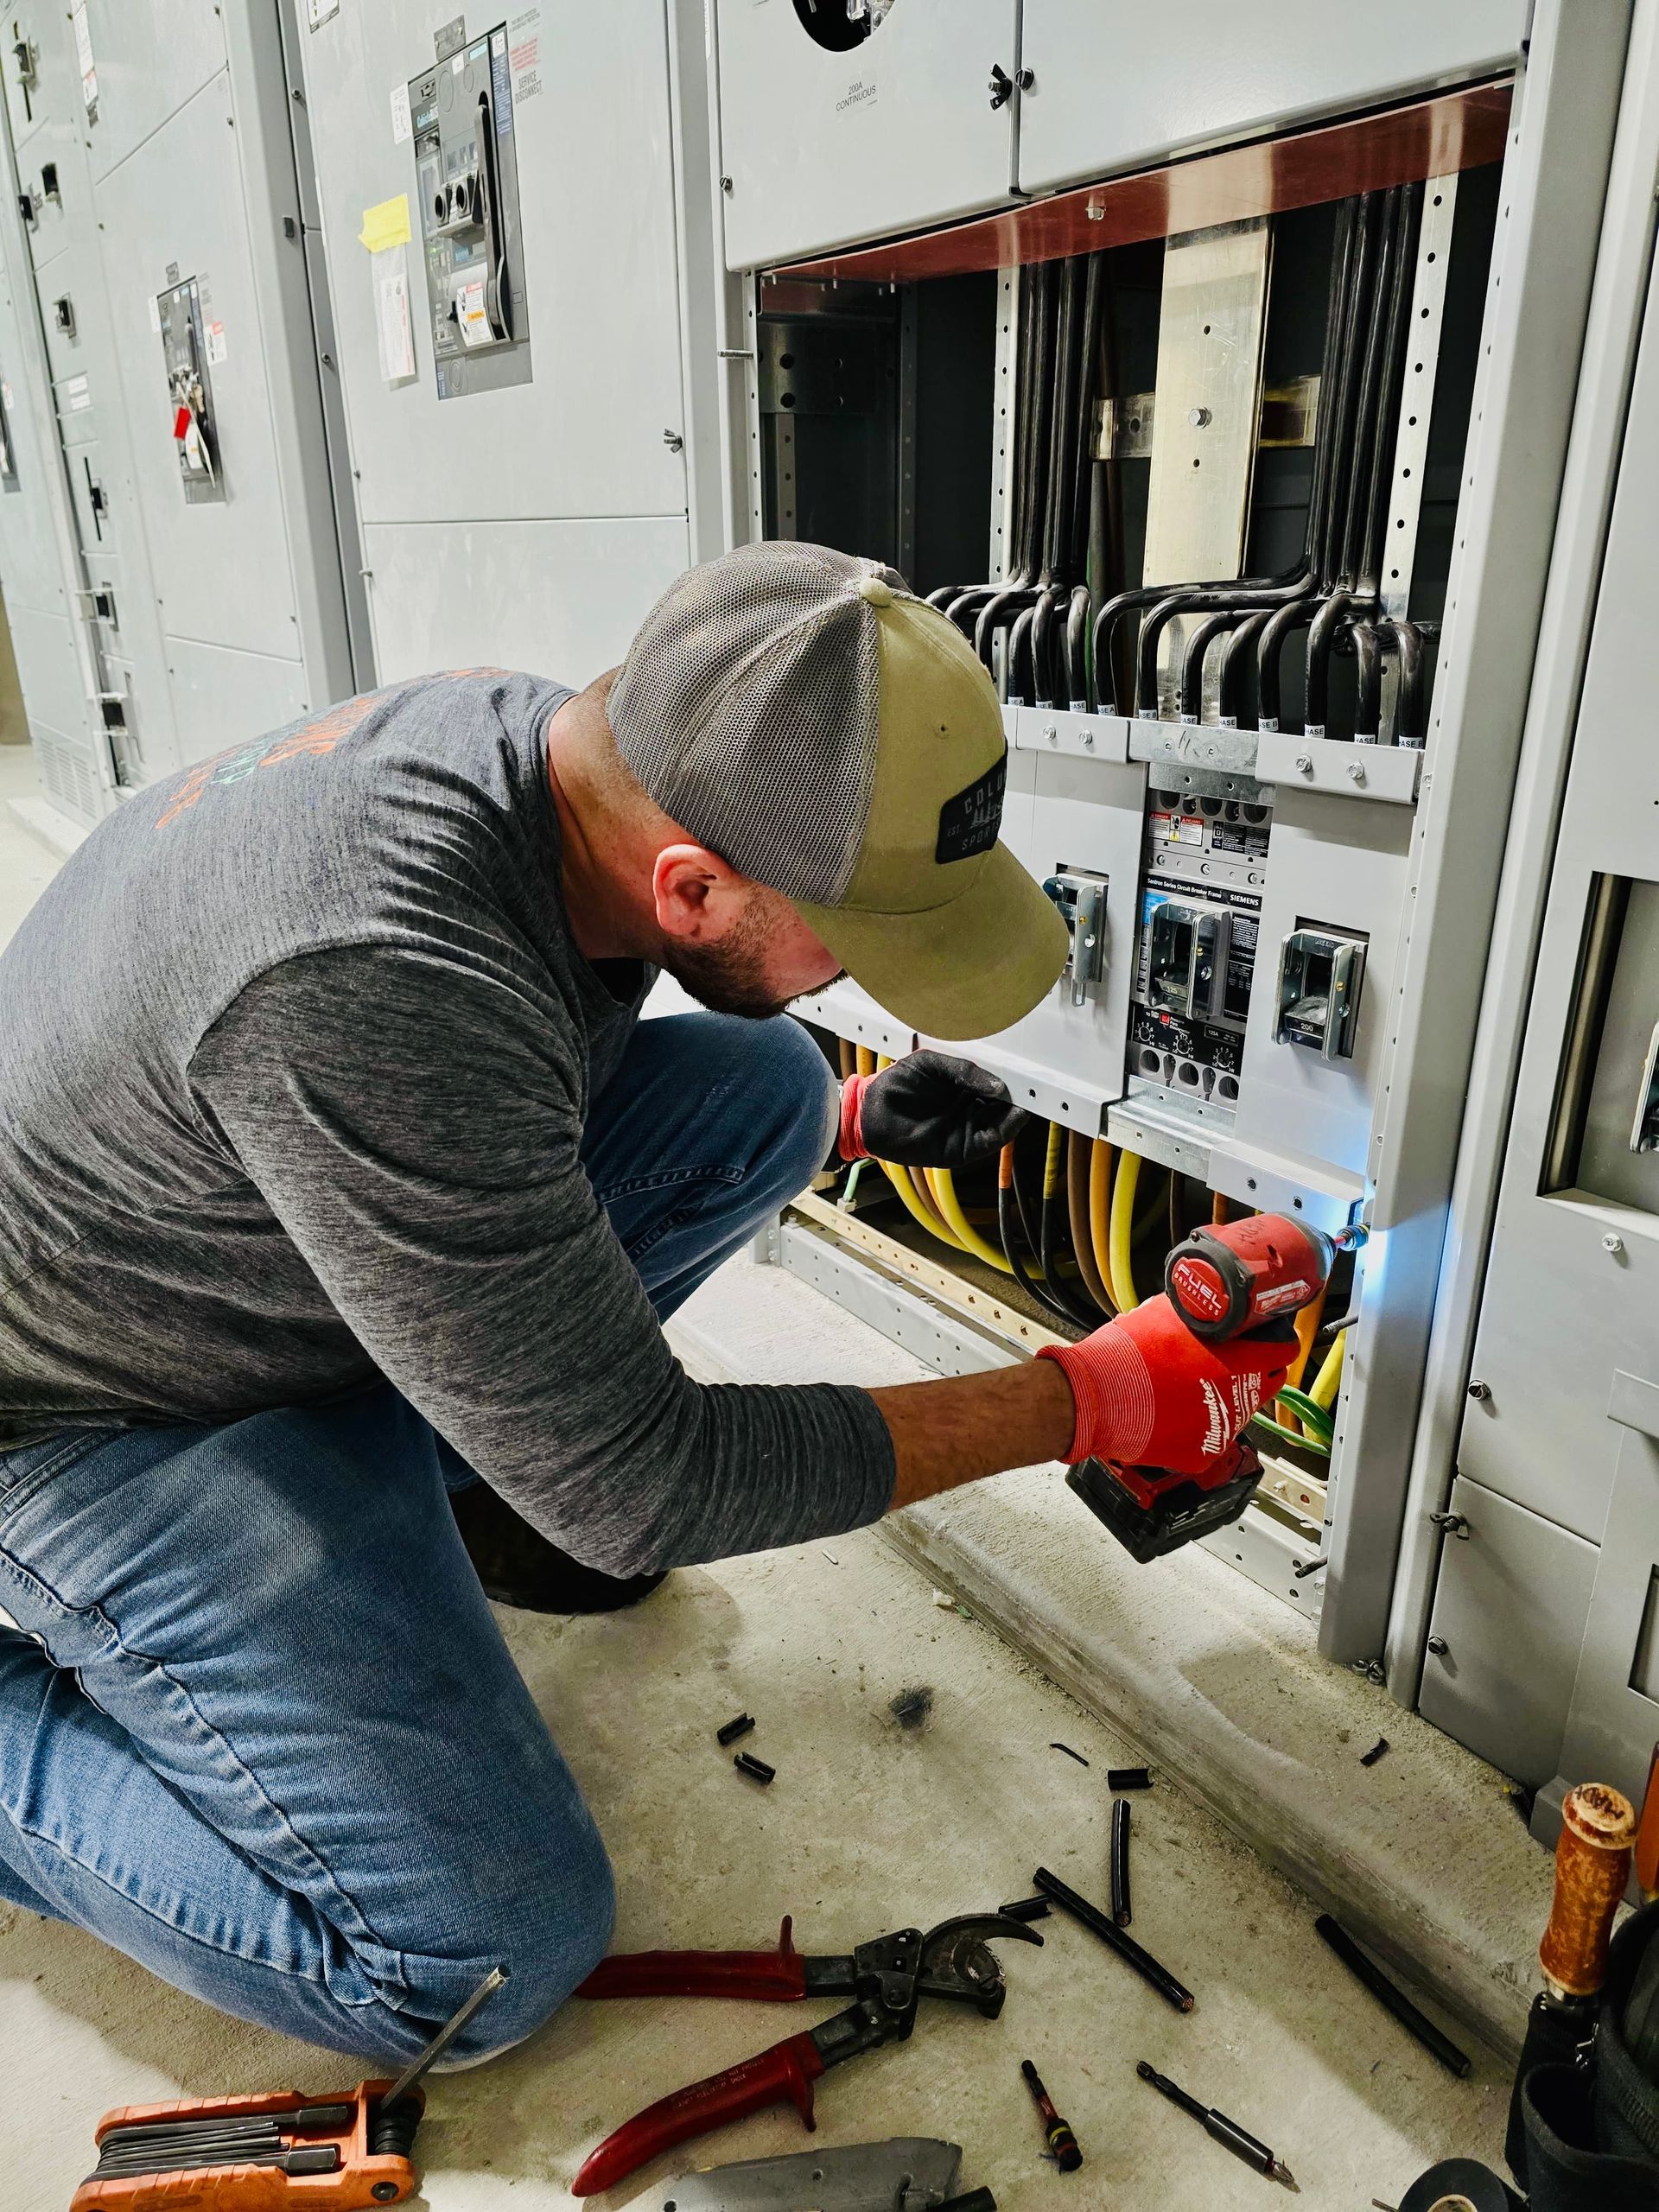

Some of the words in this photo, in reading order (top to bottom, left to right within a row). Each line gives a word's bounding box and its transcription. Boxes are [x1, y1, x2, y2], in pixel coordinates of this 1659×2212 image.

[515, 79, 542, 104] DISCONNECT
[518, 70, 537, 90] SERVICE
[849, 80, 863, 95] 200A
[836, 85, 876, 111] CONTINUOUS
[964, 768, 1006, 815] COLU
[1147, 878, 1163, 887] Sentron
[1163, 880, 1176, 889] Series
[1177, 883, 1190, 893] Circuit
[1191, 887, 1207, 896] Breaker
[1208, 890, 1222, 899] Frame
[1230, 894, 1259, 906] SIEMENS
[1166, 985, 1178, 994] 125
[1300, 1022, 1313, 1032] 200
[1174, 1272, 1219, 1316] BRUSHLESS
[1178, 1263, 1222, 1309] FUEL
[1231, 1382, 1241, 1414] LEVEL
[1200, 1380, 1222, 1457] Milwaukee
